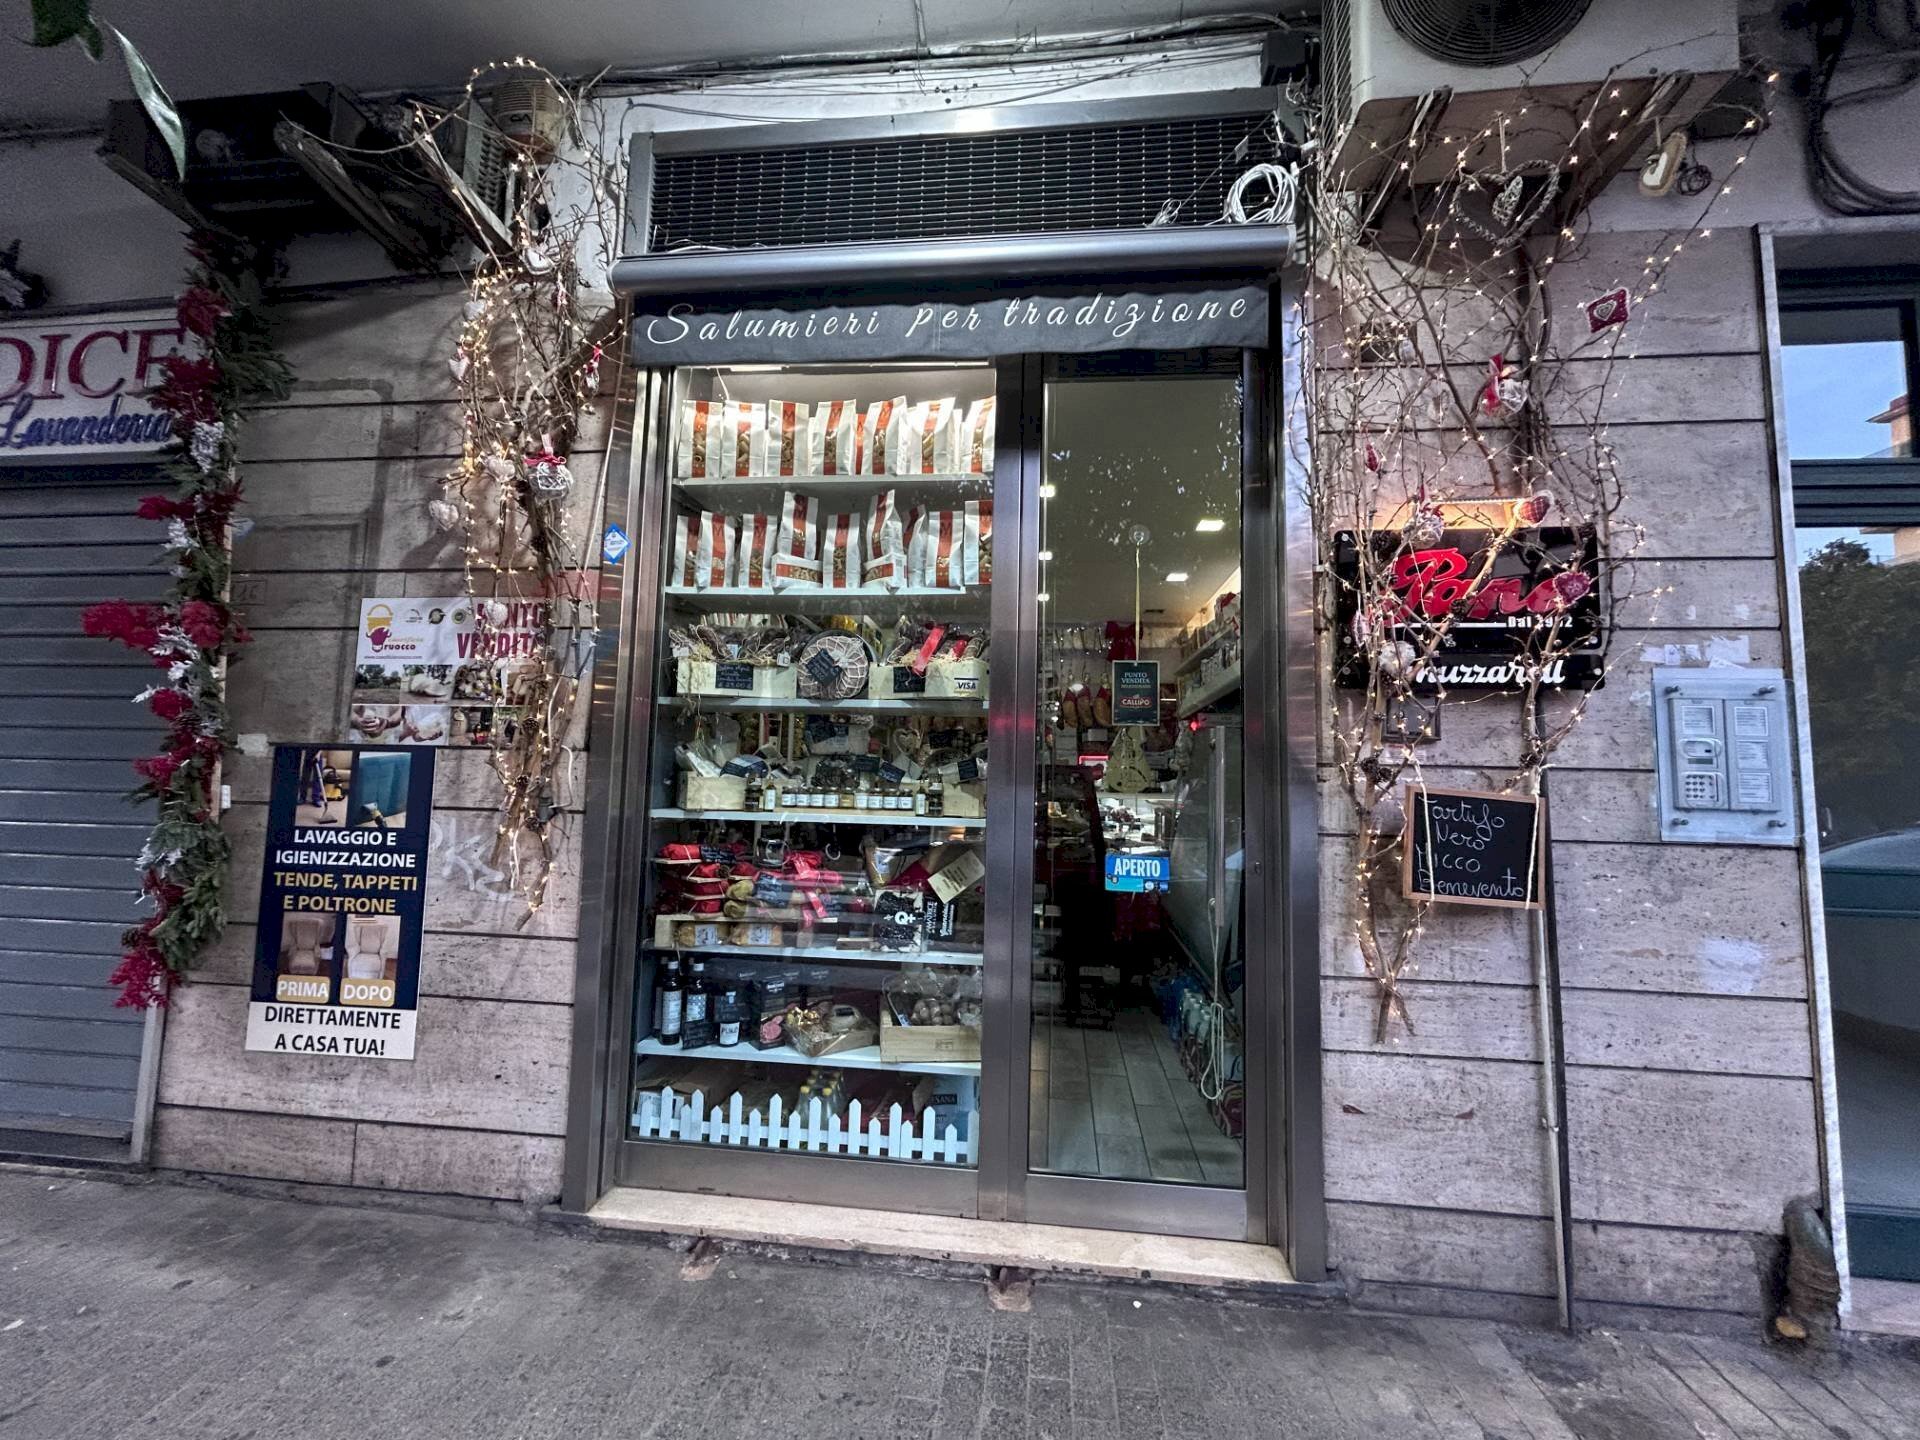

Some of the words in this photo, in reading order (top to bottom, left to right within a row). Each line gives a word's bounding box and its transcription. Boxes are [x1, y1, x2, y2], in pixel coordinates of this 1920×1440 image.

[647, 303, 880, 345] Salumieri
[905, 306, 981, 338] per
[1003, 292, 1247, 338] tradizione
[1370, 548, 1570, 626] Pan
[1508, 615, 1532, 628] Dal
[957, 682, 976, 690] VISA
[1121, 698, 1150, 706] CALLIPO
[294, 829, 382, 846] LAVAGGIO
[387, 831, 397, 846] E
[1436, 821, 1485, 850] Nero
[275, 850, 416, 868] IGIENIZZAZIONE
[1114, 858, 1161, 877] APERTO
[274, 871, 338, 890] TENDE,
[342, 874, 417, 891] TAPPETI
[283, 895, 294, 910] E
[298, 896, 396, 914] POLTRONE
[277, 980, 329, 998] PRIMA
[343, 984, 393, 1002] DOPO
[264, 1006, 402, 1030] DIRETTAMENTE
[274, 1033, 287, 1050] A
[292, 1034, 339, 1054] CASA
[344, 1037, 386, 1056] TUA!
